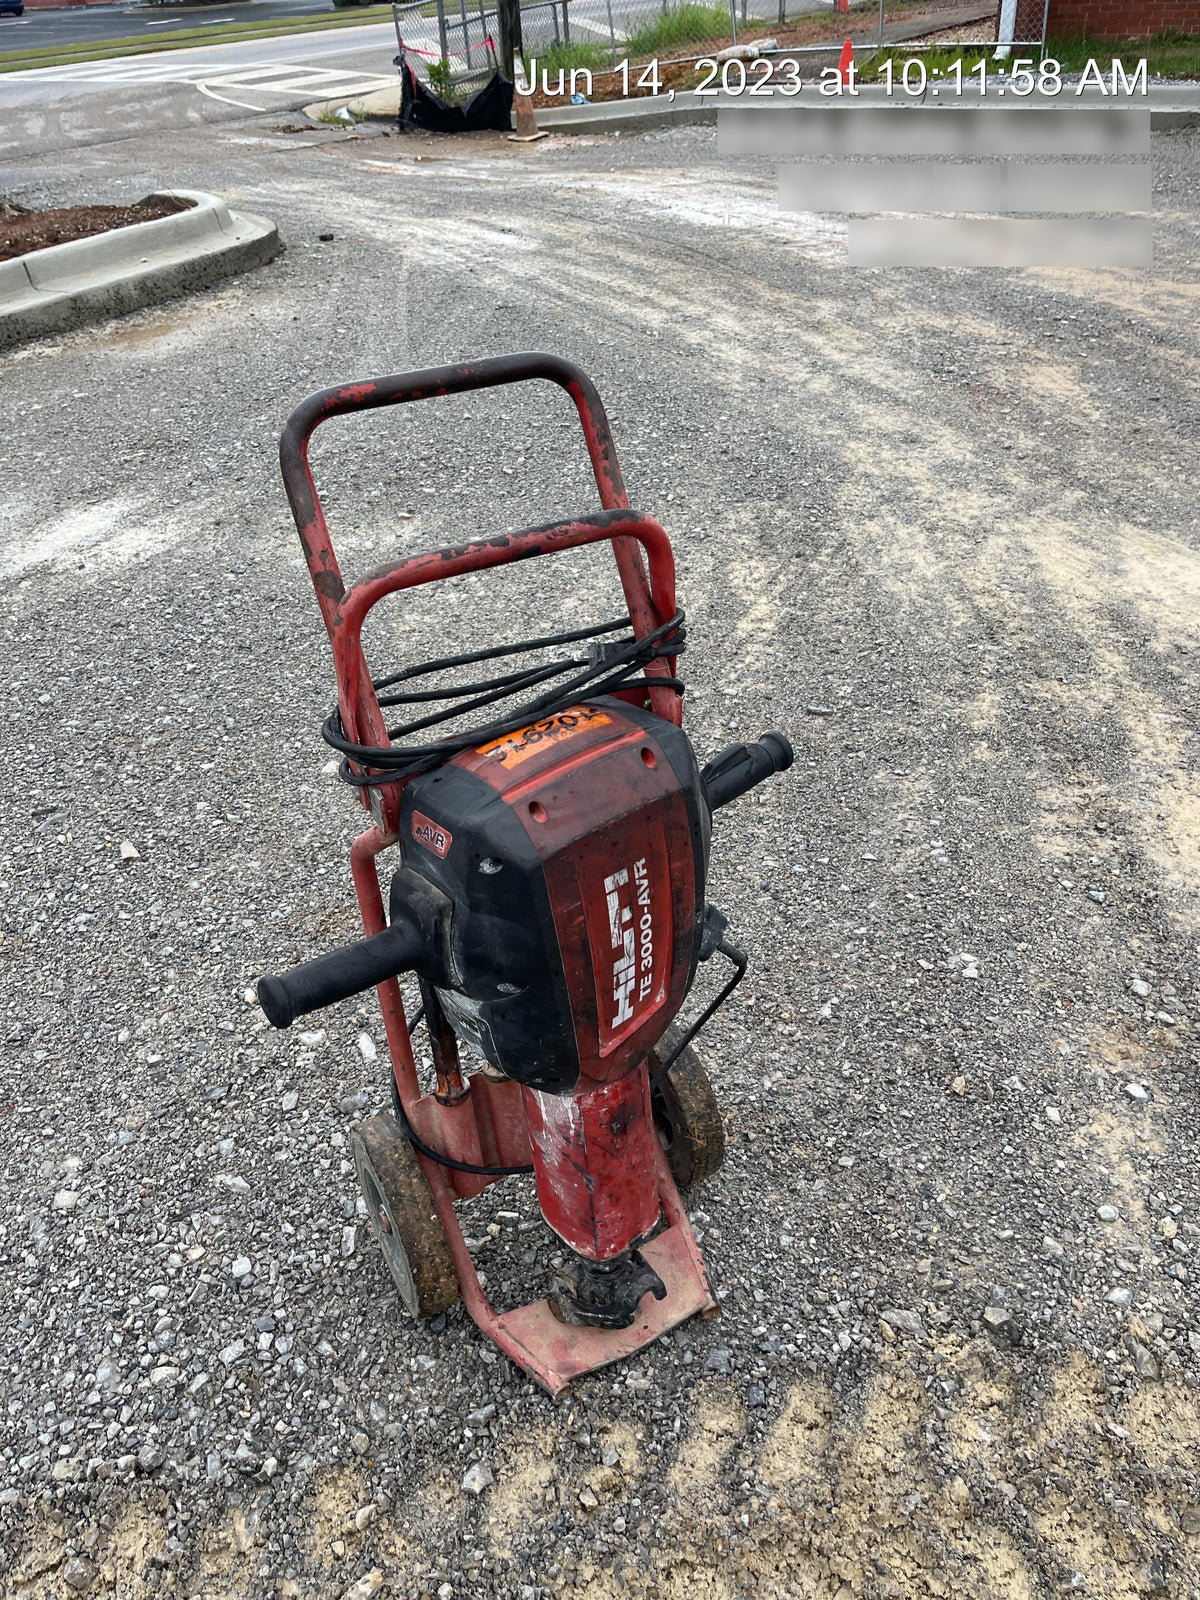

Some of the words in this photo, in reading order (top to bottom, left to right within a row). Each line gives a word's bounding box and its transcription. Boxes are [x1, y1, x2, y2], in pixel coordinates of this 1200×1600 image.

[421, 825, 445, 848] AVR
[603, 867, 636, 1030] HILTI
[633, 856, 653, 972] 3000-AVR
[638, 972, 653, 1002] TE
